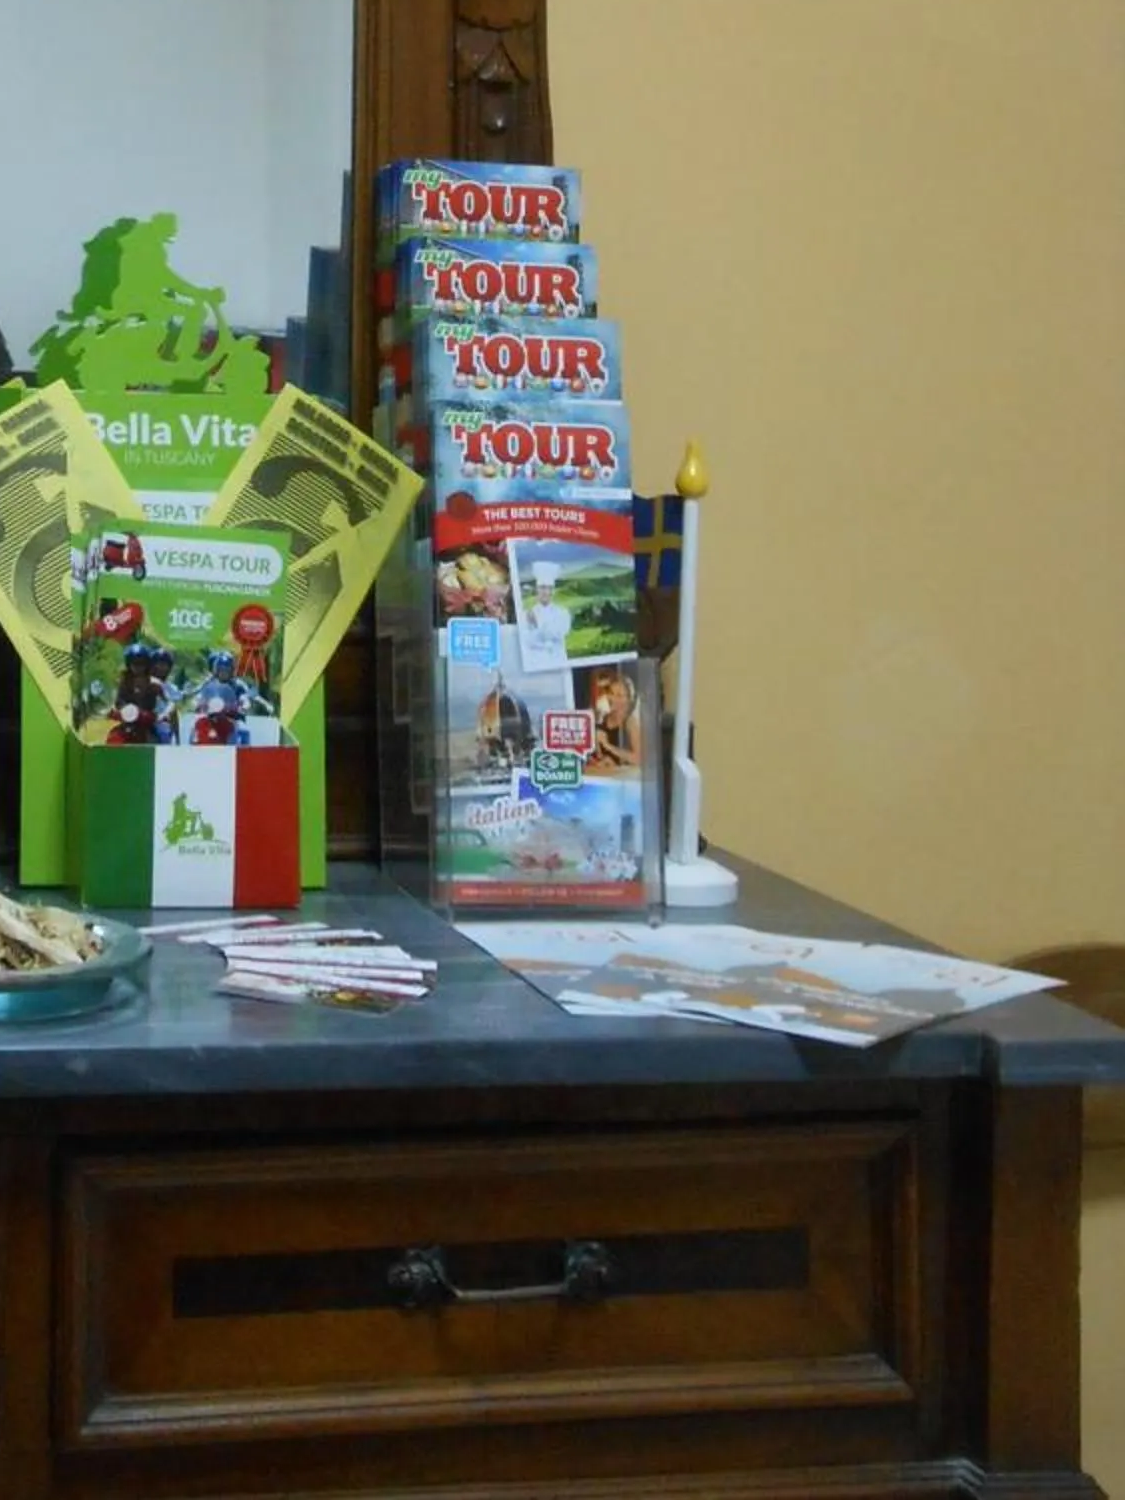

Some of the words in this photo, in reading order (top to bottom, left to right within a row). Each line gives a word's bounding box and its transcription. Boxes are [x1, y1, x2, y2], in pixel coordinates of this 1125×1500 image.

[403, 169, 444, 188] my
[413, 181, 566, 228] TOUR
[414, 249, 455, 267] my
[424, 259, 581, 306] TOUR
[435, 323, 476, 341] my
[446, 334, 607, 381] TOUR
[85, 411, 172, 445] Bella
[179, 414, 258, 447] Vita
[444, 411, 484, 429] my
[452, 422, 616, 470] TOUR
[145, 451, 217, 467] TUSCANY
[141, 503, 188, 520] ESPA
[483, 509, 508, 522] THE
[510, 506, 540, 520] BEST
[544, 507, 586, 523] TOURS
[154, 550, 213, 569] VESPA
[219, 555, 272, 575] TOUR
